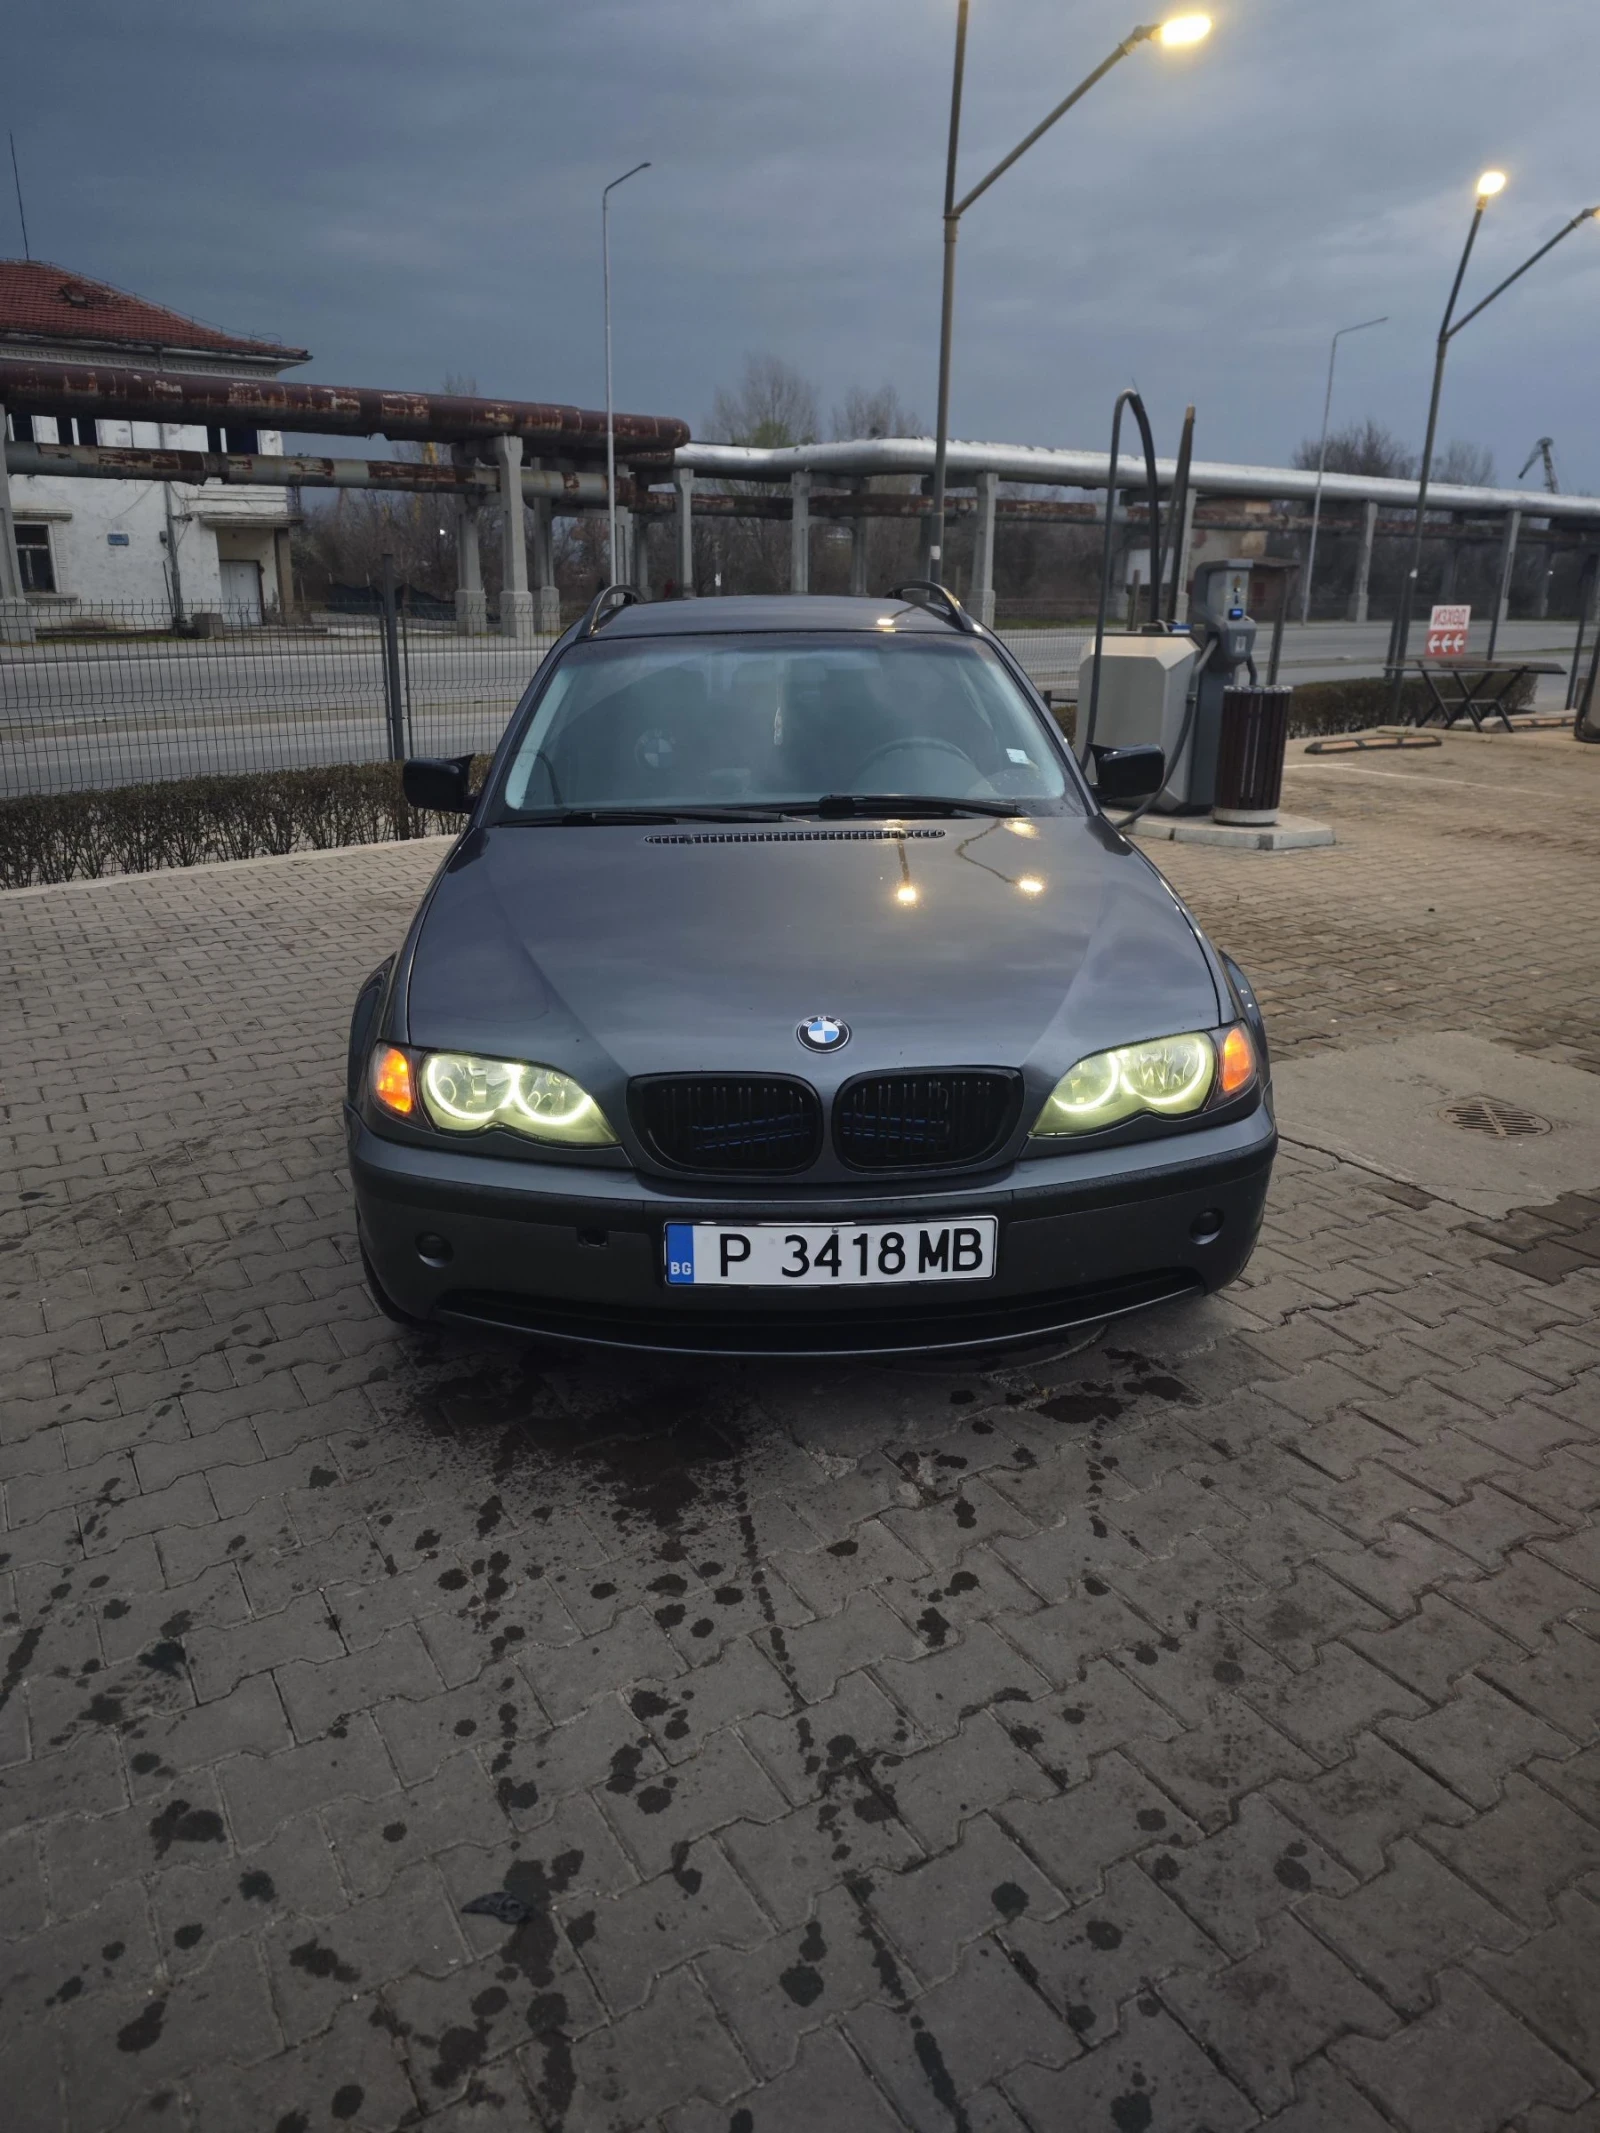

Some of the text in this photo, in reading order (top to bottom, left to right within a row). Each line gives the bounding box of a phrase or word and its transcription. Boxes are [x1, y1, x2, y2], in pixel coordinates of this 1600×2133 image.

[670, 1261, 693, 1275] BG
[719, 1227, 984, 1278] P 3418 MB
